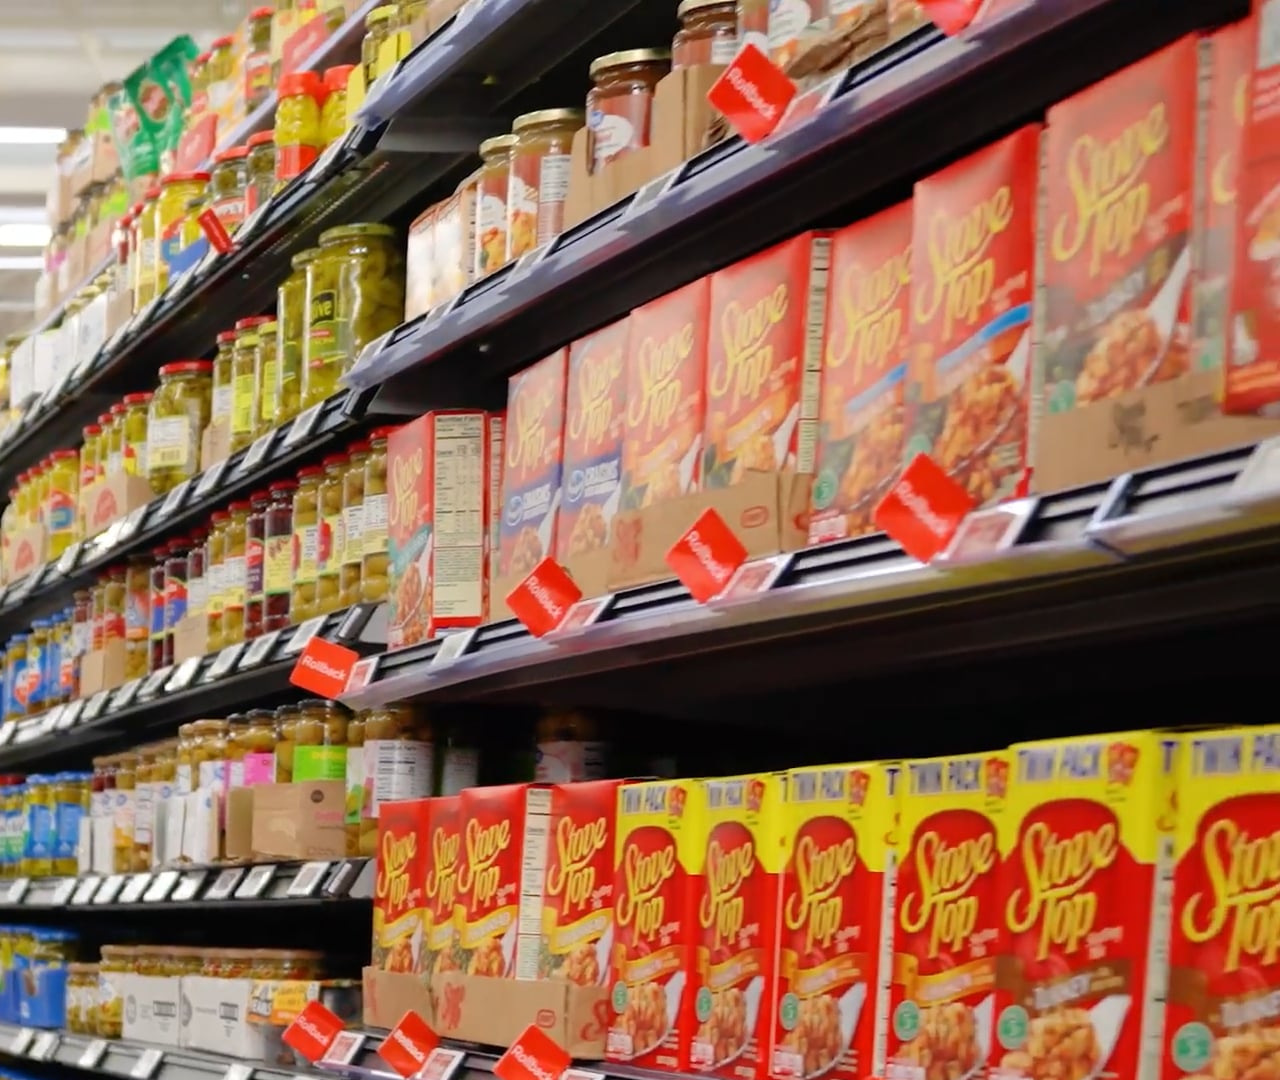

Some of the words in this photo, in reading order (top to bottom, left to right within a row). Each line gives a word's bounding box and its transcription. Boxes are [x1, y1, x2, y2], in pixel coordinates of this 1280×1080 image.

[725, 68, 777, 120] Rollback
[1053, 102, 1168, 262] Stove
[915, 187, 1013, 325] Stove
[1089, 185, 1151, 277] Top
[941, 259, 995, 340] Top
[629, 324, 694, 428] Stove
[712, 283, 789, 398] Stove
[736, 335, 773, 418] Top
[853, 309, 902, 384] Top
[569, 349, 623, 440] Stove
[585, 396, 613, 453] Top
[647, 377, 682, 441] Top
[391, 449, 422, 525] Stove
[399, 491, 418, 538] Top
[685, 528, 727, 583] Rollback
[525, 573, 563, 620] Rollback
[301, 655, 346, 683] Rollback
[377, 830, 417, 898] Stove
[458, 818, 511, 893] Stove
[547, 817, 608, 896] Stove
[563, 866, 596, 916] Top
[617, 844, 674, 927] Stove
[700, 840, 753, 929] Stove
[786, 836, 858, 930] Stove
[900, 830, 996, 934] Stove
[1005, 822, 1120, 934] Stove
[386, 873, 411, 915] Top
[472, 871, 501, 913] Top
[632, 897, 665, 949] Top
[714, 897, 744, 950] Top
[806, 897, 844, 955] Top
[928, 894, 979, 960] Top
[1039, 893, 1098, 962] Top
[394, 1028, 425, 1064] Rollback
